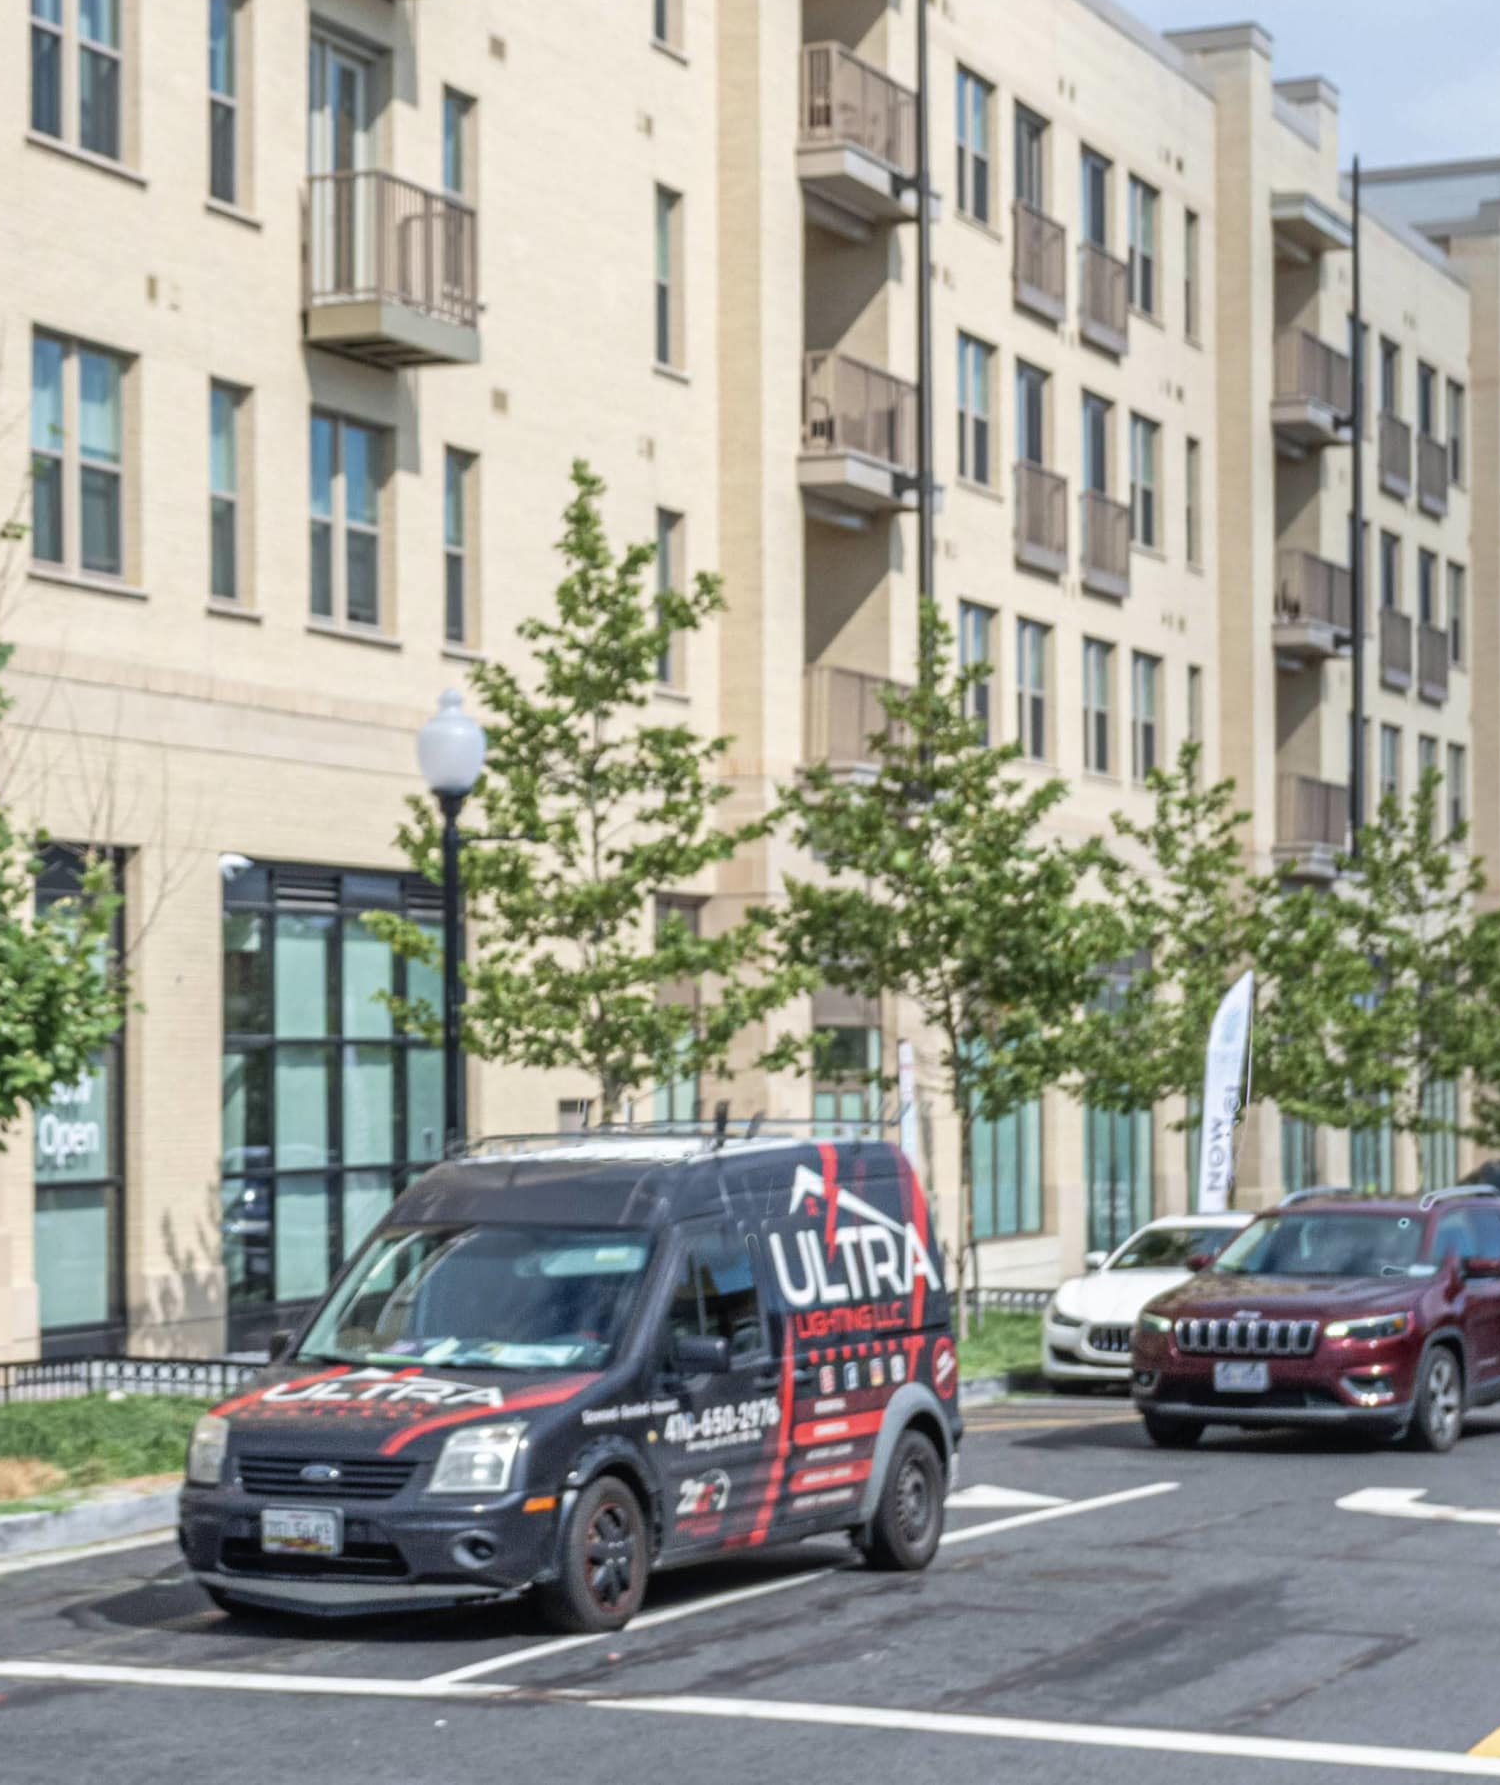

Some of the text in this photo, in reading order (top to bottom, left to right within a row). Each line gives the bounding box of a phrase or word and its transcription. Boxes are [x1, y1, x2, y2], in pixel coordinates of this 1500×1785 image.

[40, 1113, 99, 1168] Open
[769, 1221, 942, 1307] ULTRA
[262, 1381, 505, 1408] ULTRA
